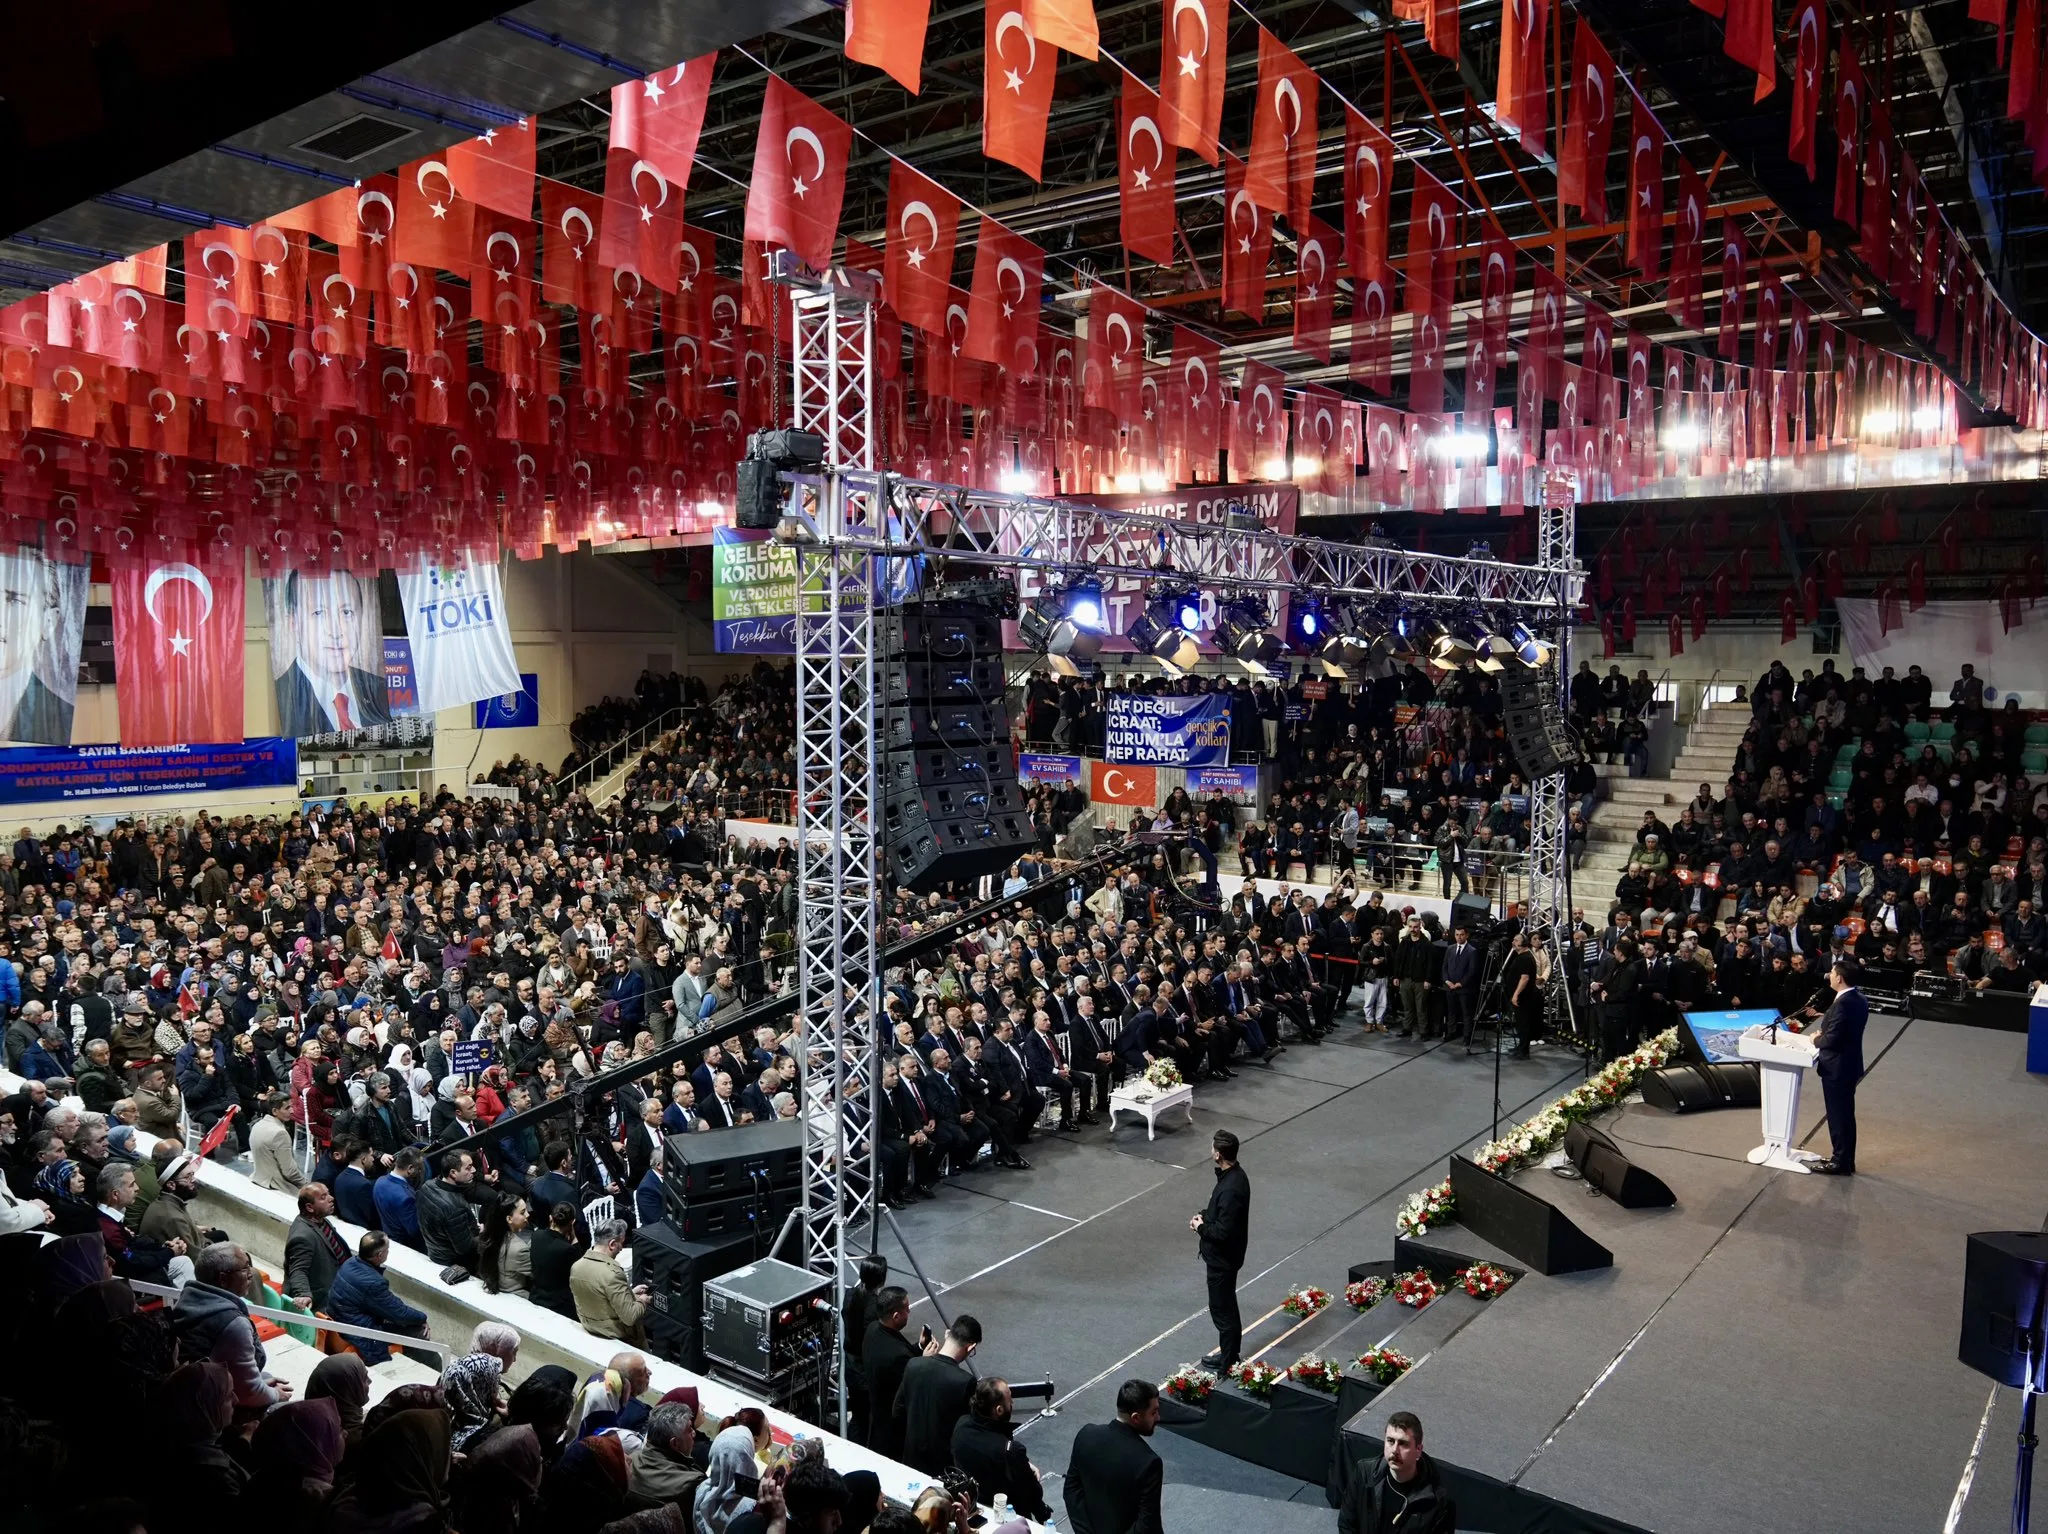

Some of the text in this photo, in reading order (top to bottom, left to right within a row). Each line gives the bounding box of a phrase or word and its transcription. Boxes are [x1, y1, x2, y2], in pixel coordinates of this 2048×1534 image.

[1109, 699, 1184, 717] LAF DEĞİL,
[1186, 719, 1218, 737] gençlik
[79, 746, 116, 757] SAYIN
[212, 752, 255, 763] DESTEK
[258, 751, 274, 761] VE
[1107, 746, 1190, 762] HEP RAHAT.
